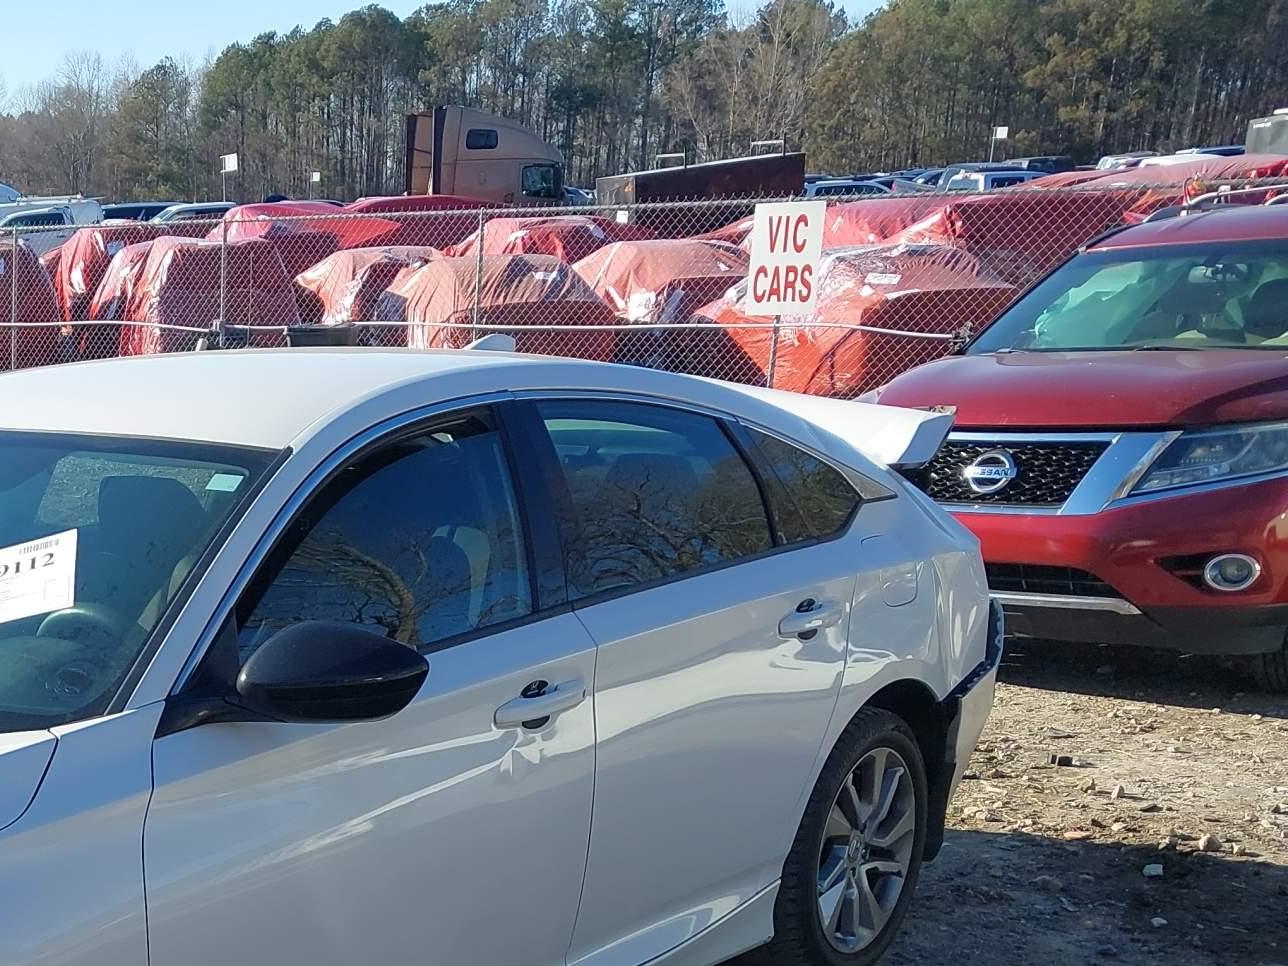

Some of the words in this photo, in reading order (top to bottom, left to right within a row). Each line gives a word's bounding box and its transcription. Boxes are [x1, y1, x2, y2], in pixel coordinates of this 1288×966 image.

[768, 213, 809, 254] VIC
[753, 263, 813, 304] CARS
[969, 467, 1010, 477] SSAN
